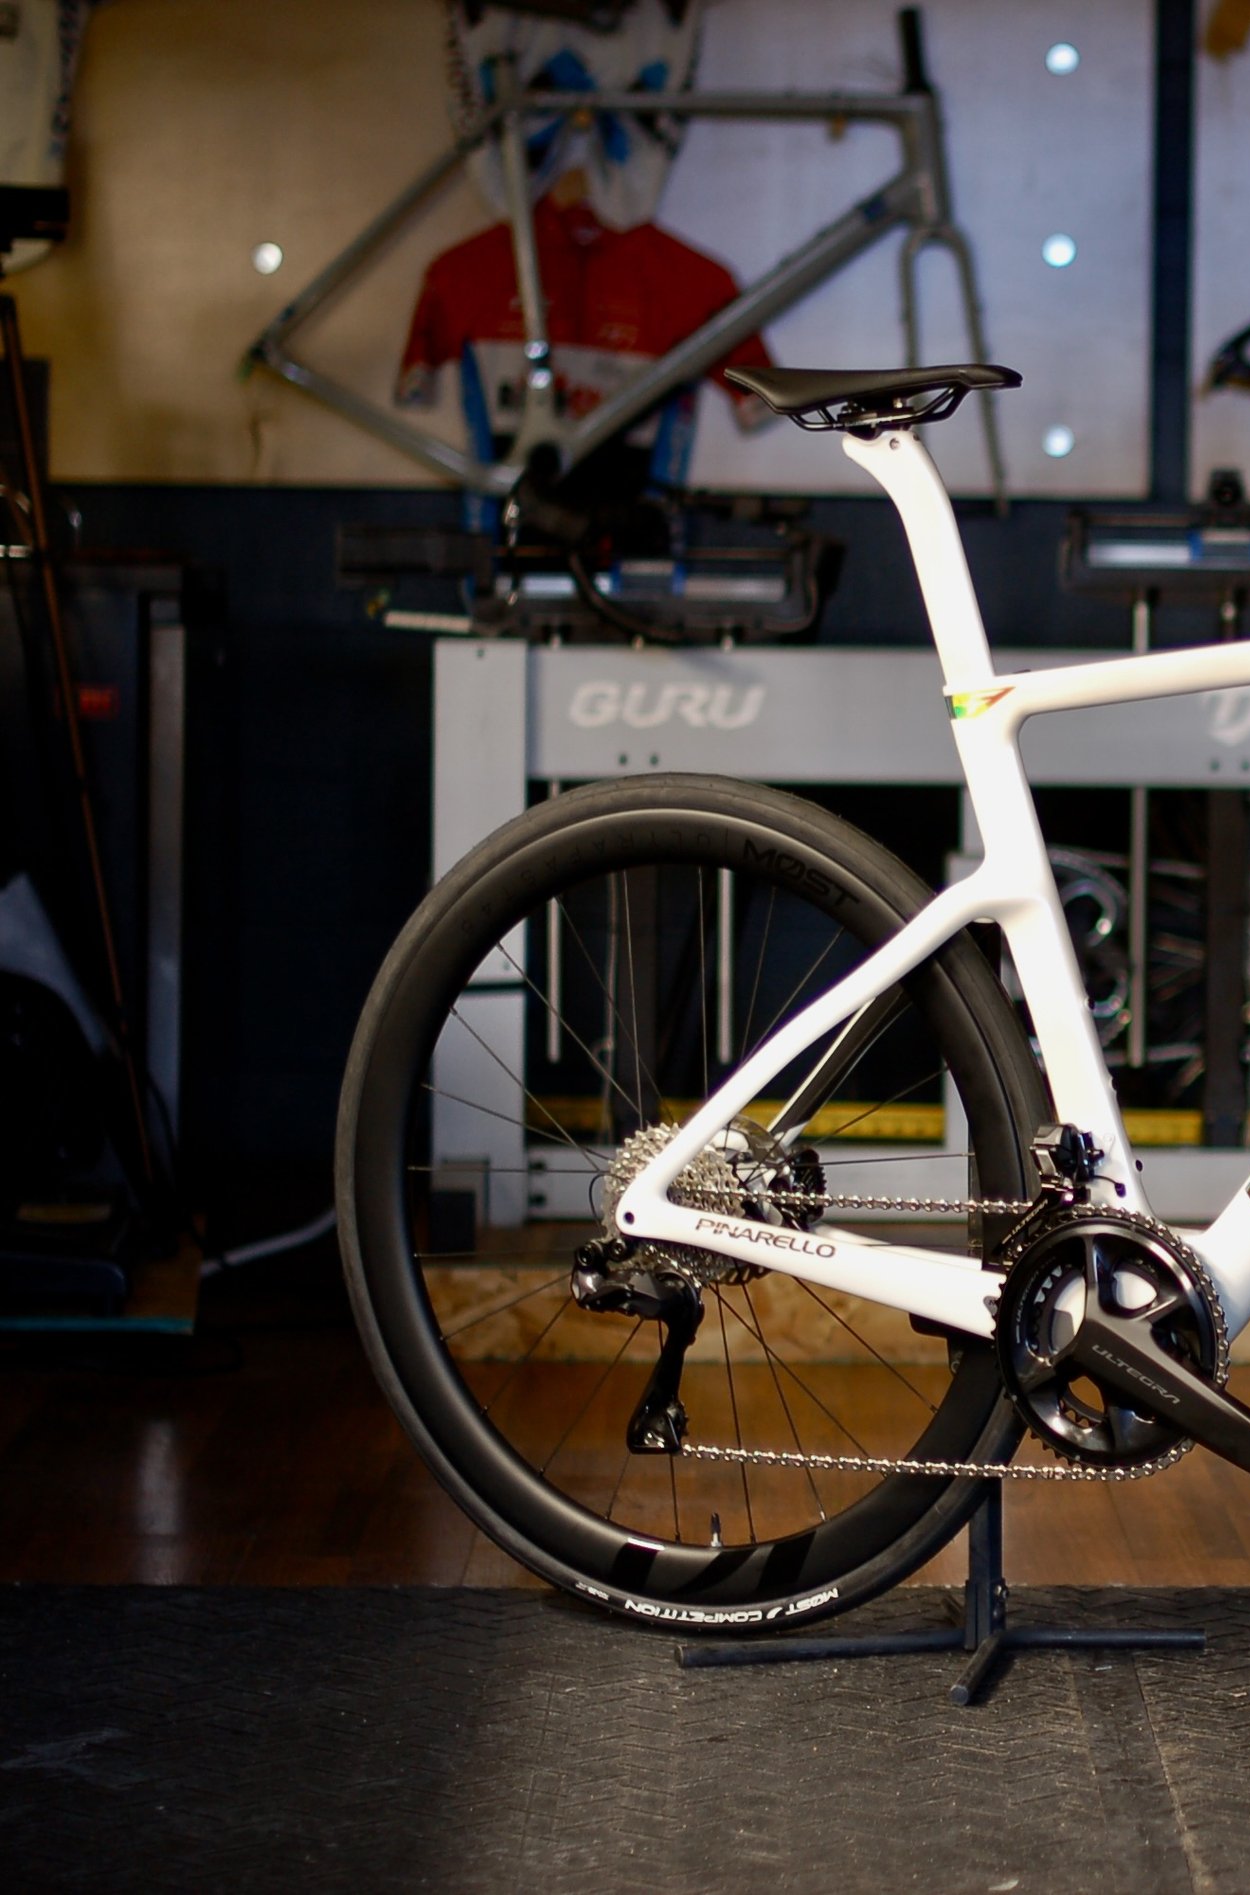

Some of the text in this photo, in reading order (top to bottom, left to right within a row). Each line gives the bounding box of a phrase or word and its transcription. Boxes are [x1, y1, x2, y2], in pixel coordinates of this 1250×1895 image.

[569, 681, 766, 729] GURU
[695, 1218, 836, 1258] PINARELLO
[1091, 1344, 1181, 1405] ULTEGRA
[625, 1599, 763, 1624] COMPETITION
